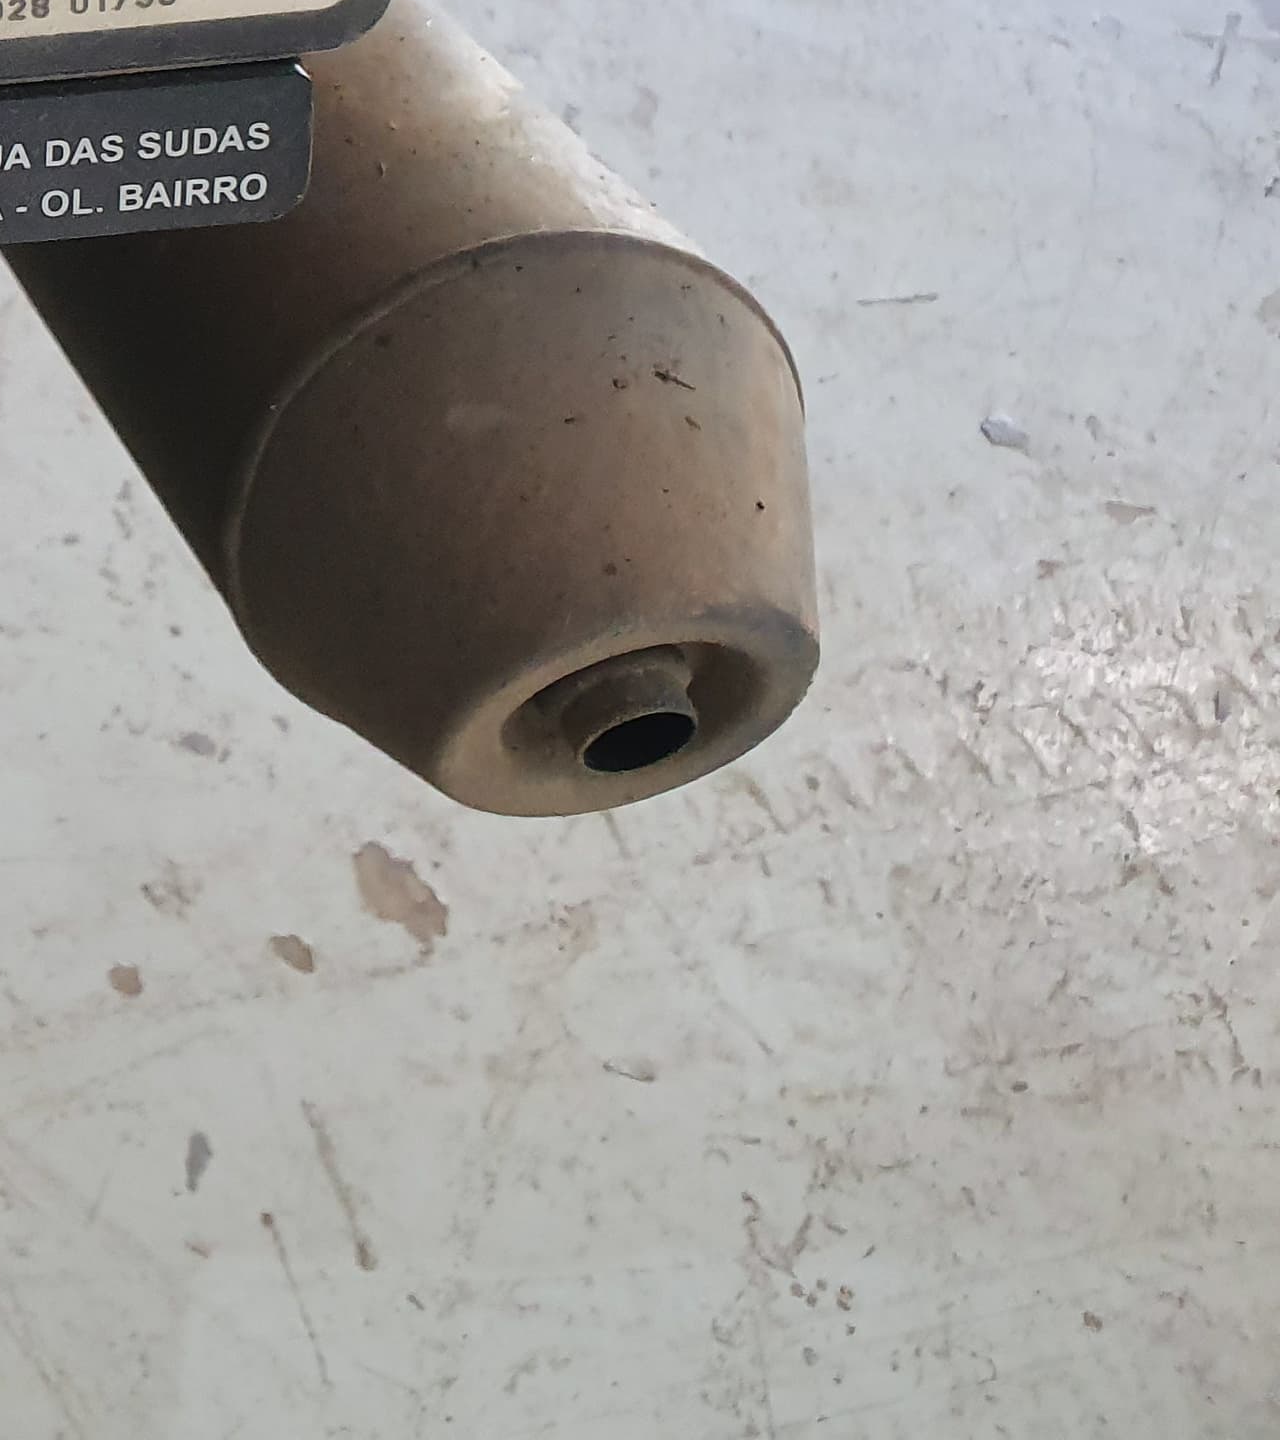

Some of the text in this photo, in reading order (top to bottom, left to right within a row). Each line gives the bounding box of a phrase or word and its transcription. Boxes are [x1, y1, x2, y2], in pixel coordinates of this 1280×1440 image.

[45, 134, 124, 167] DAS
[137, 122, 270, 159] SUDAS
[41, 188, 104, 217] OL.
[119, 173, 268, 212] BAIRRO
